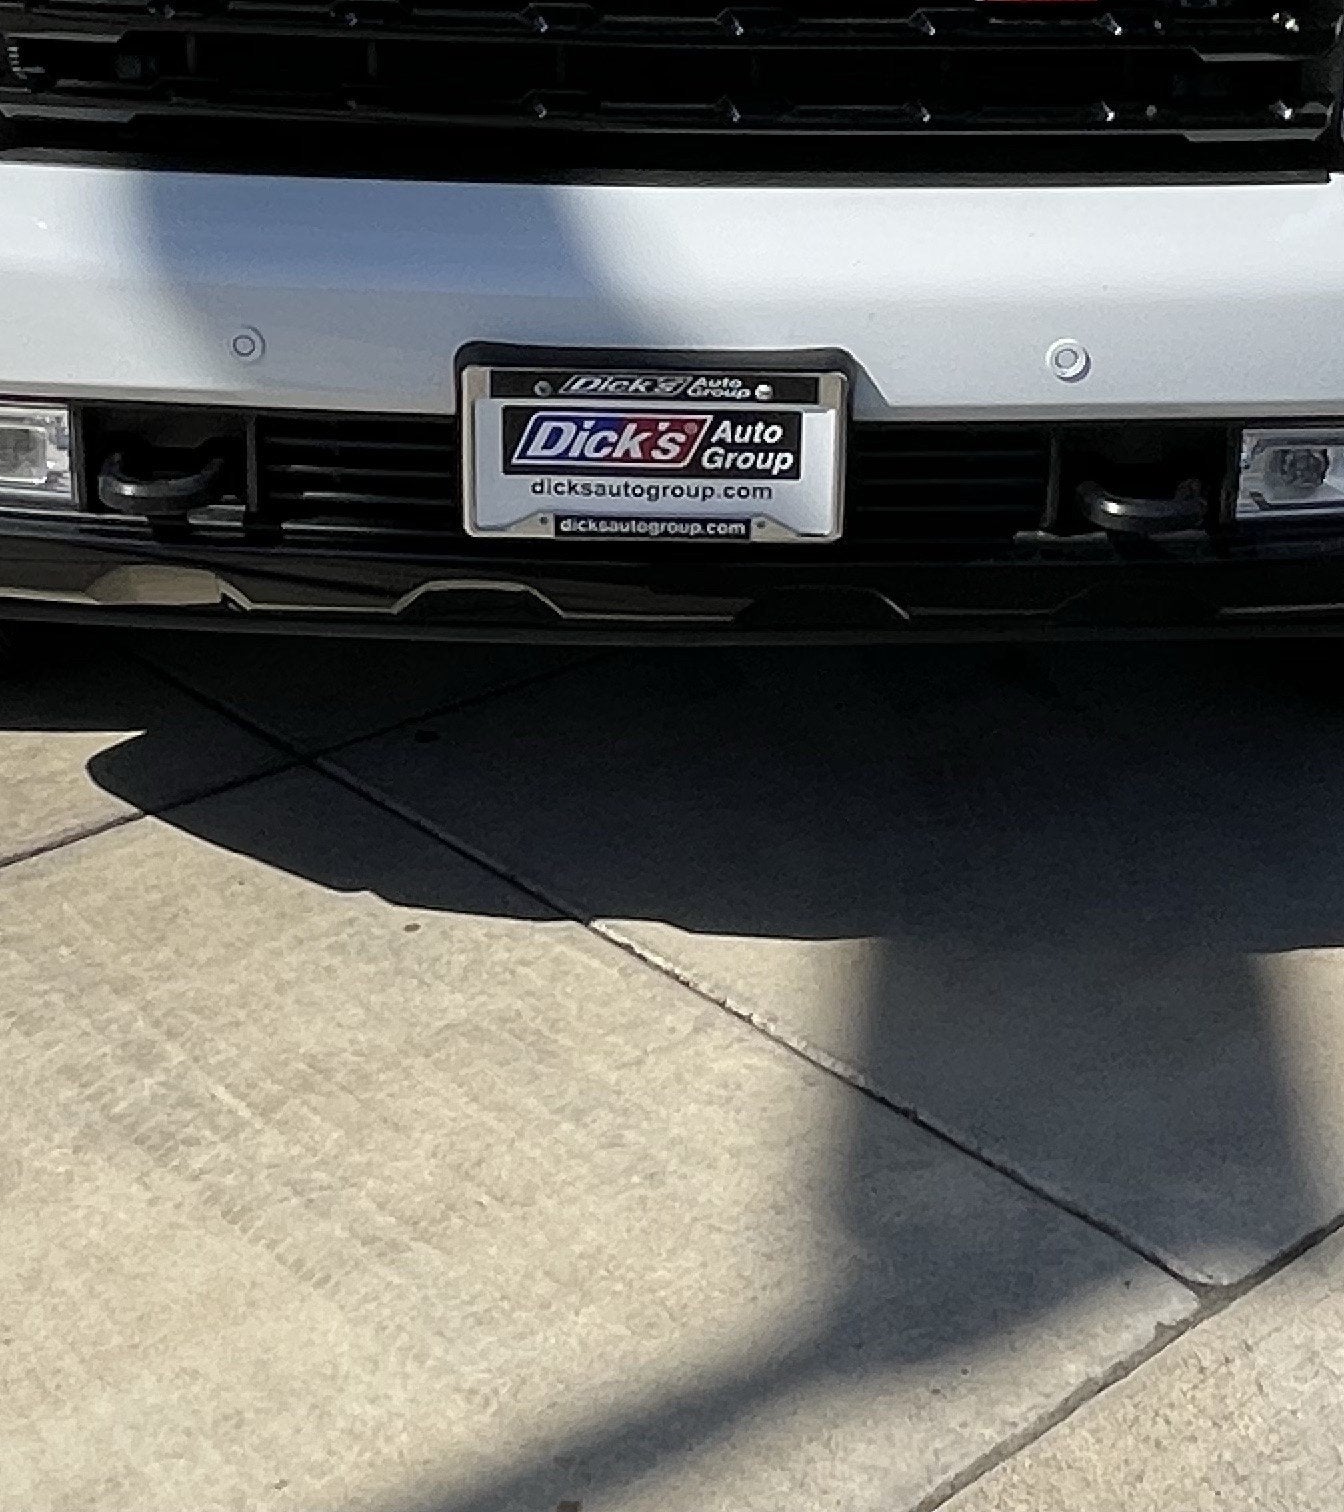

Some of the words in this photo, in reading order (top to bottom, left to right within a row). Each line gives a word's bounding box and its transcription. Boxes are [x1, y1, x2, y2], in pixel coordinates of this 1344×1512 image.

[690, 376, 743, 388] Auto
[525, 419, 686, 461] Dick's
[710, 421, 784, 445] Auto
[701, 447, 794, 476] Group
[531, 478, 773, 502] dicksautogroup.com
[559, 518, 747, 536] dicksautogroup.com
